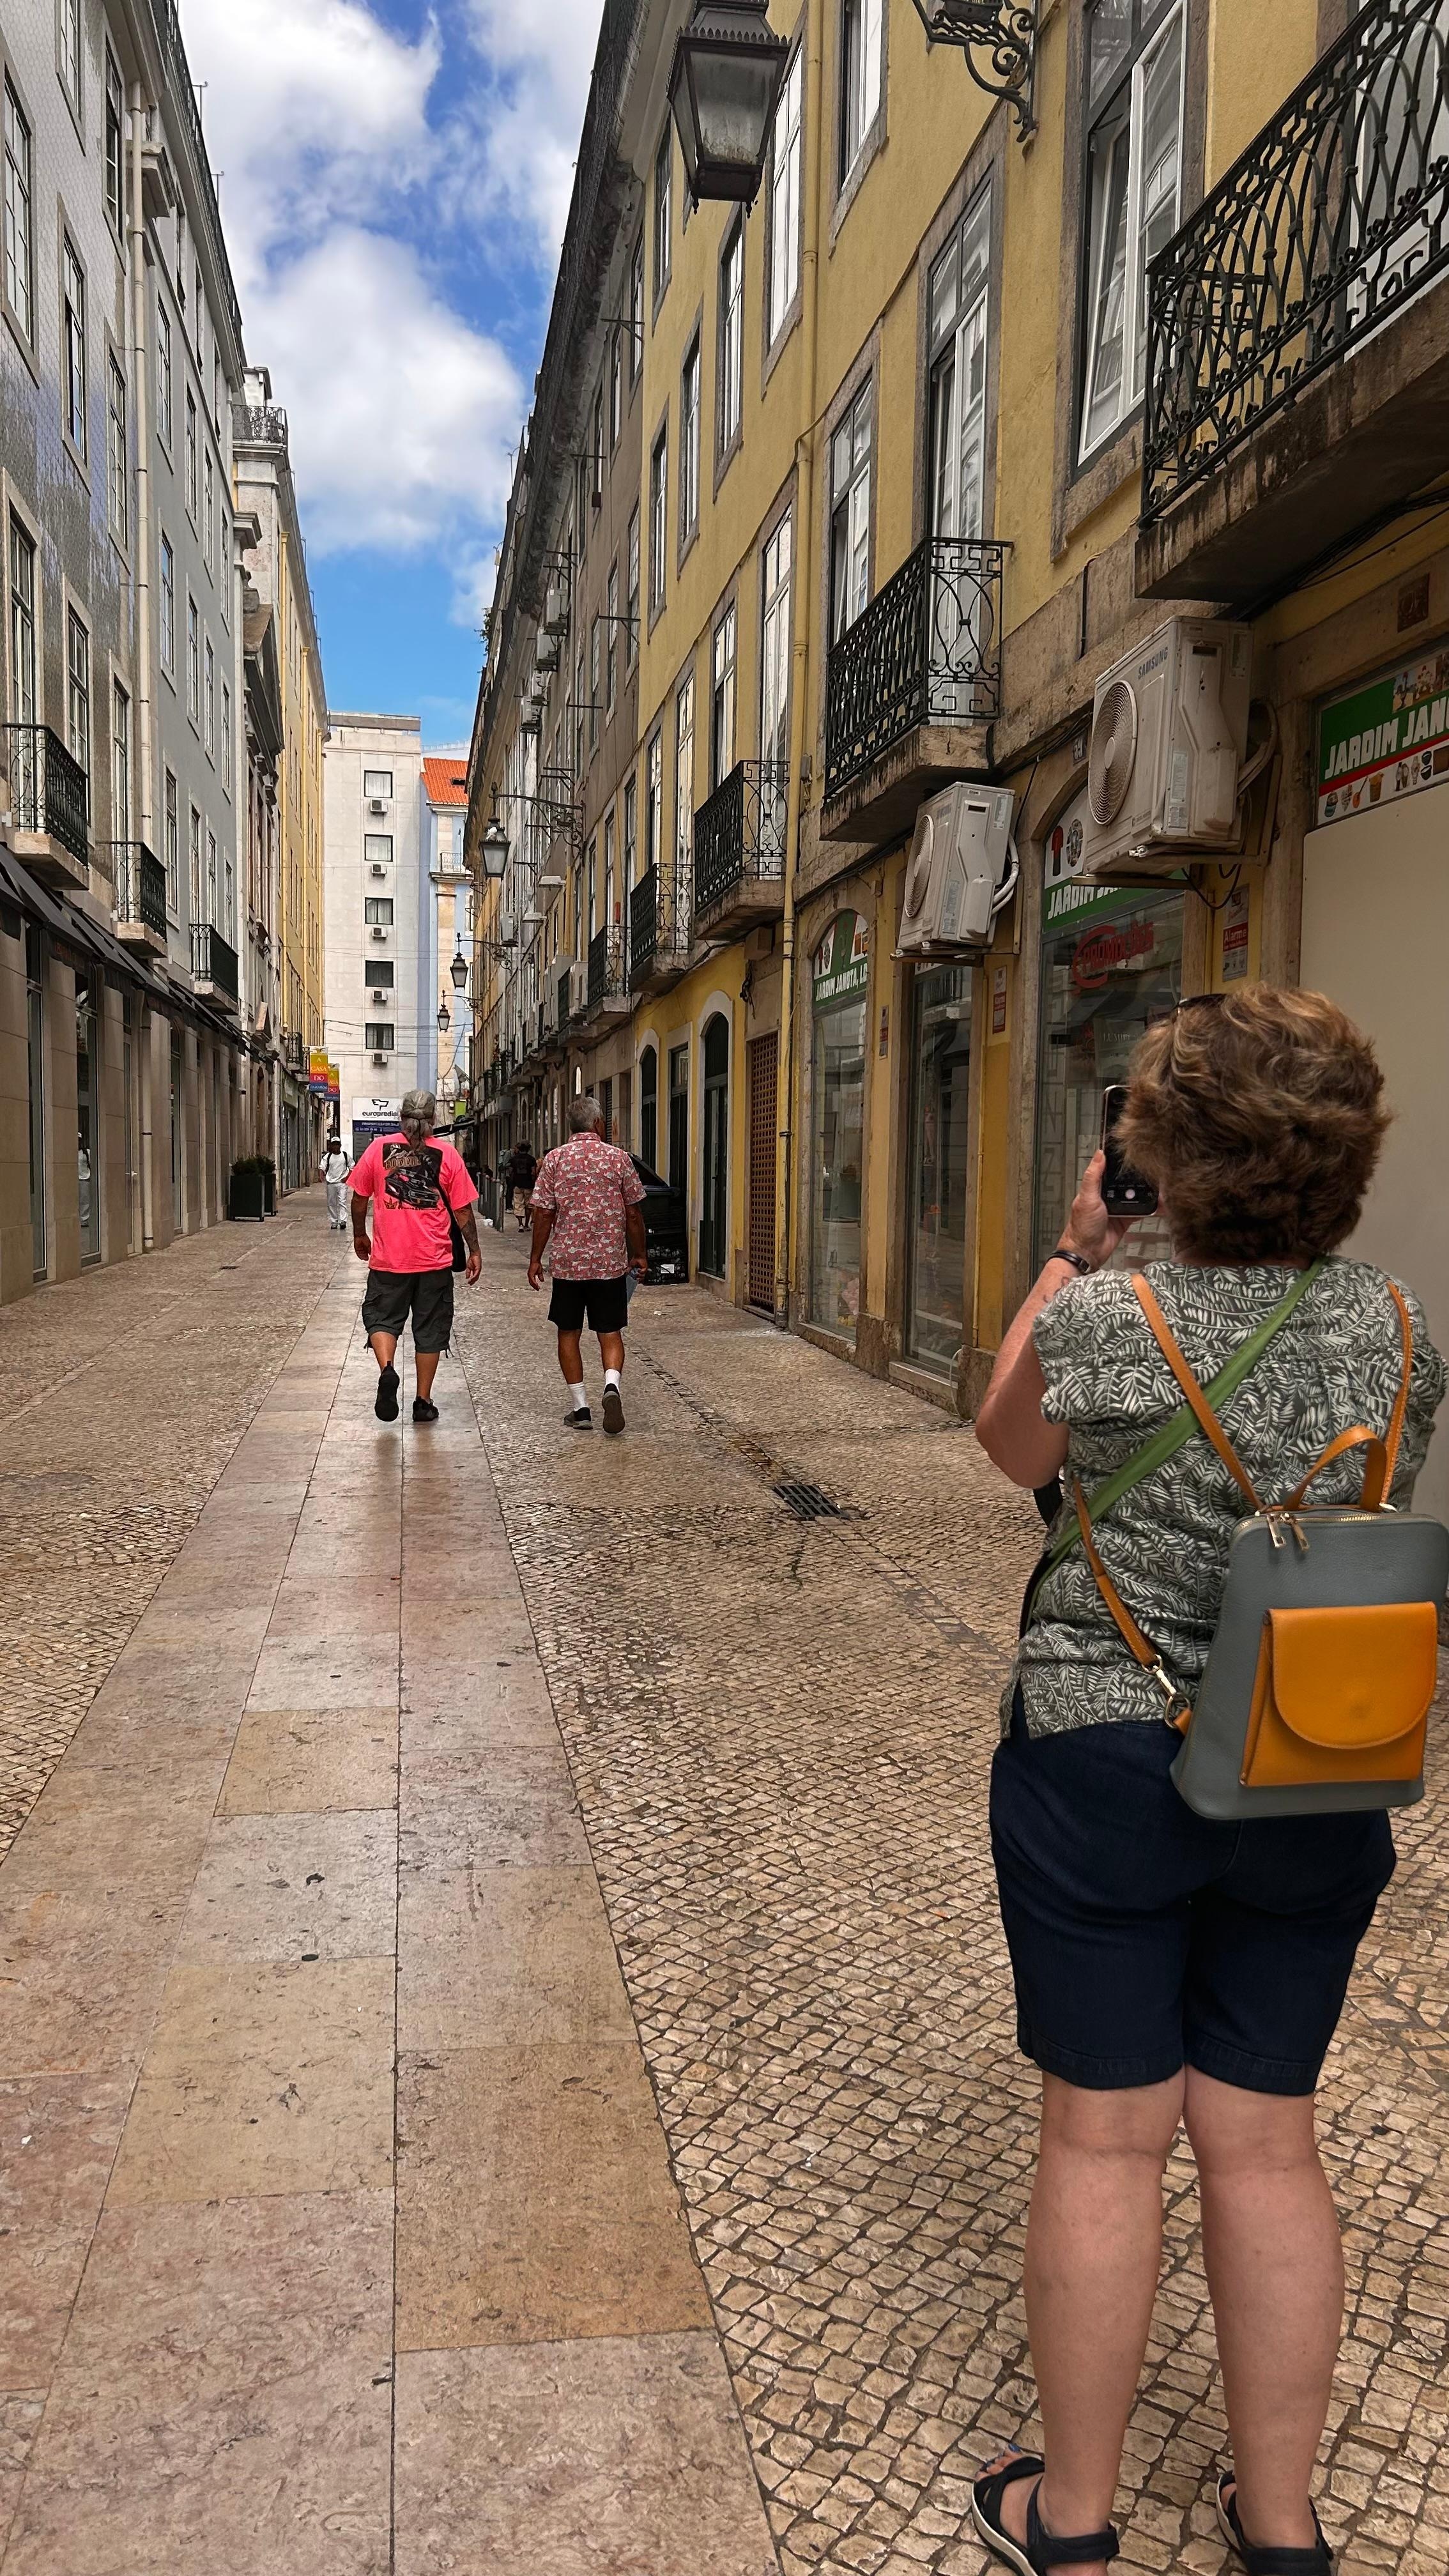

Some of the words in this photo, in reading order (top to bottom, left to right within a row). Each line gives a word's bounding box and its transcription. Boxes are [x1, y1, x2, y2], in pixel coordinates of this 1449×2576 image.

[1138, 647, 1169, 680] SAMSUNG
[1324, 717, 1399, 780] JARDIM
[1224, 930, 1247, 942] Alarme
[816, 976, 836, 1002] JARDIM
